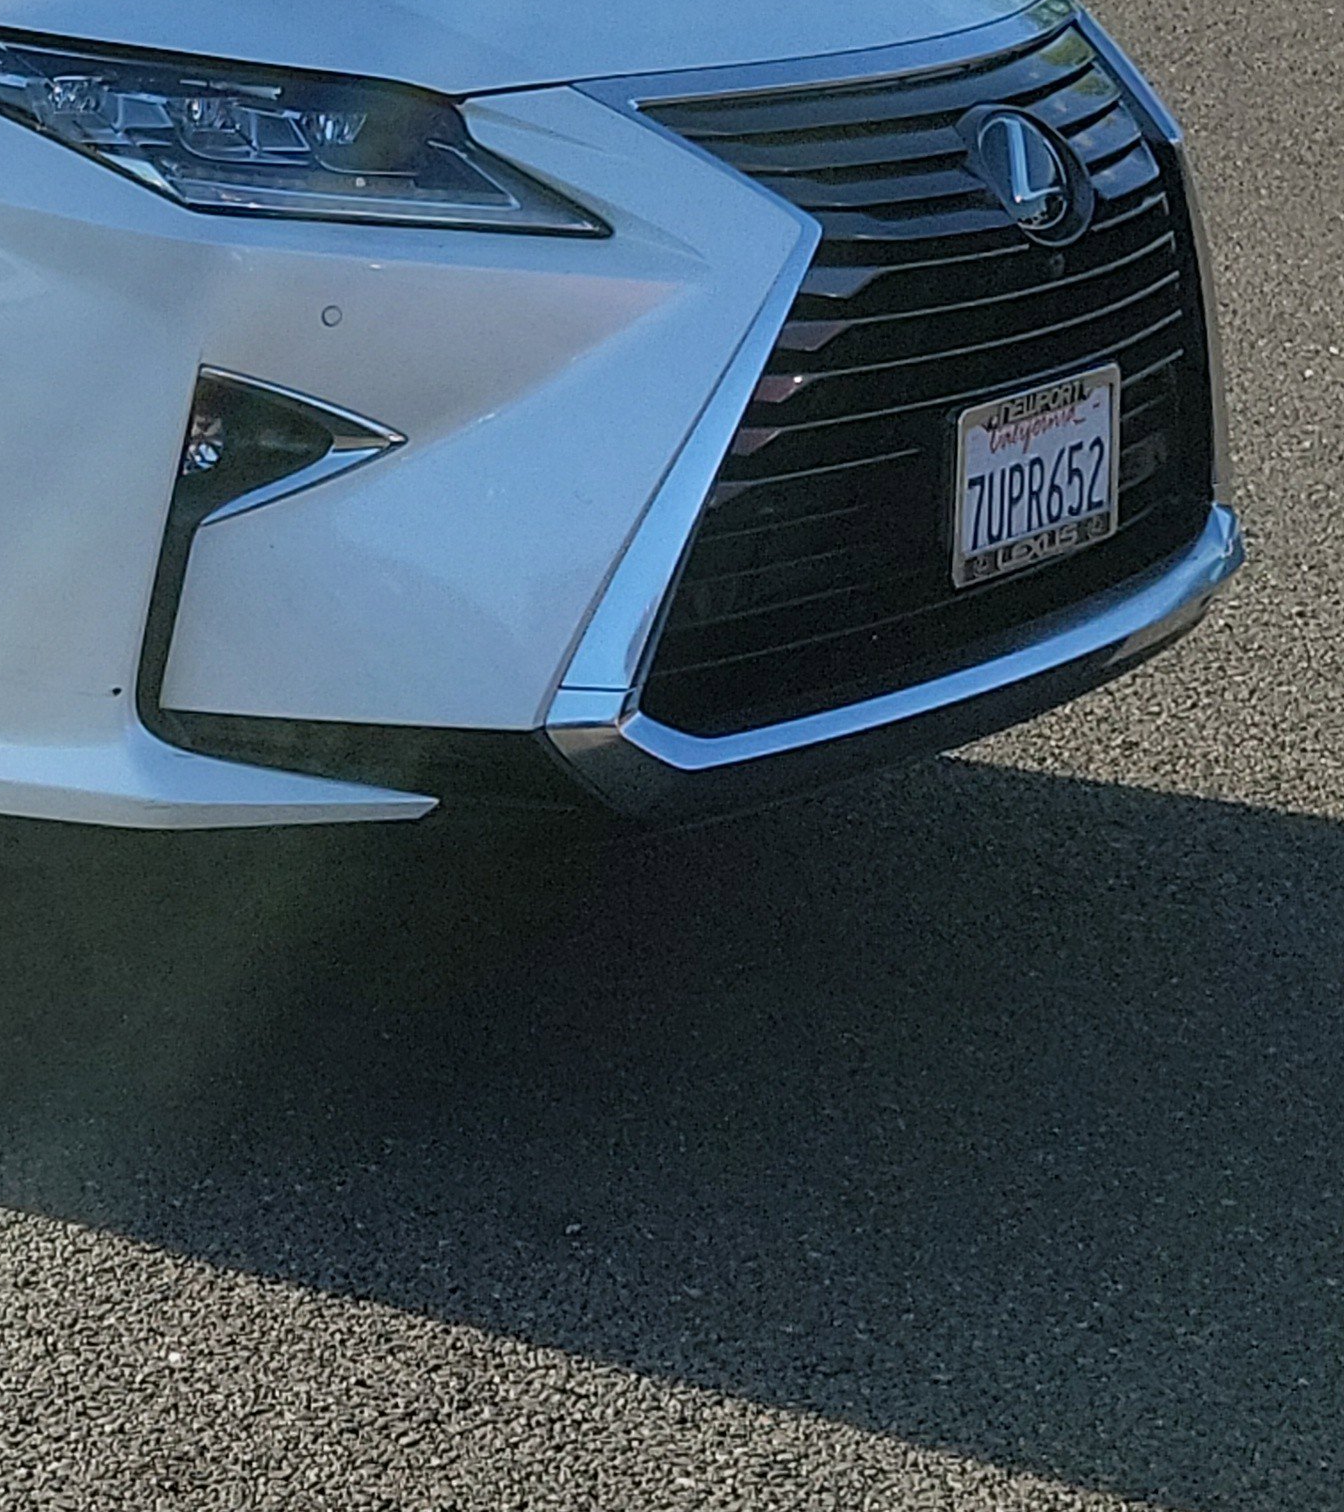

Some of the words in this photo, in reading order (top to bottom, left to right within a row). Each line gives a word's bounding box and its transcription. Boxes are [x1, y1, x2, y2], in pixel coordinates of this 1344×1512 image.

[989, 405, 1086, 454] California
[967, 435, 1105, 551] 7UPR652
[997, 523, 1079, 572] LEXUS
